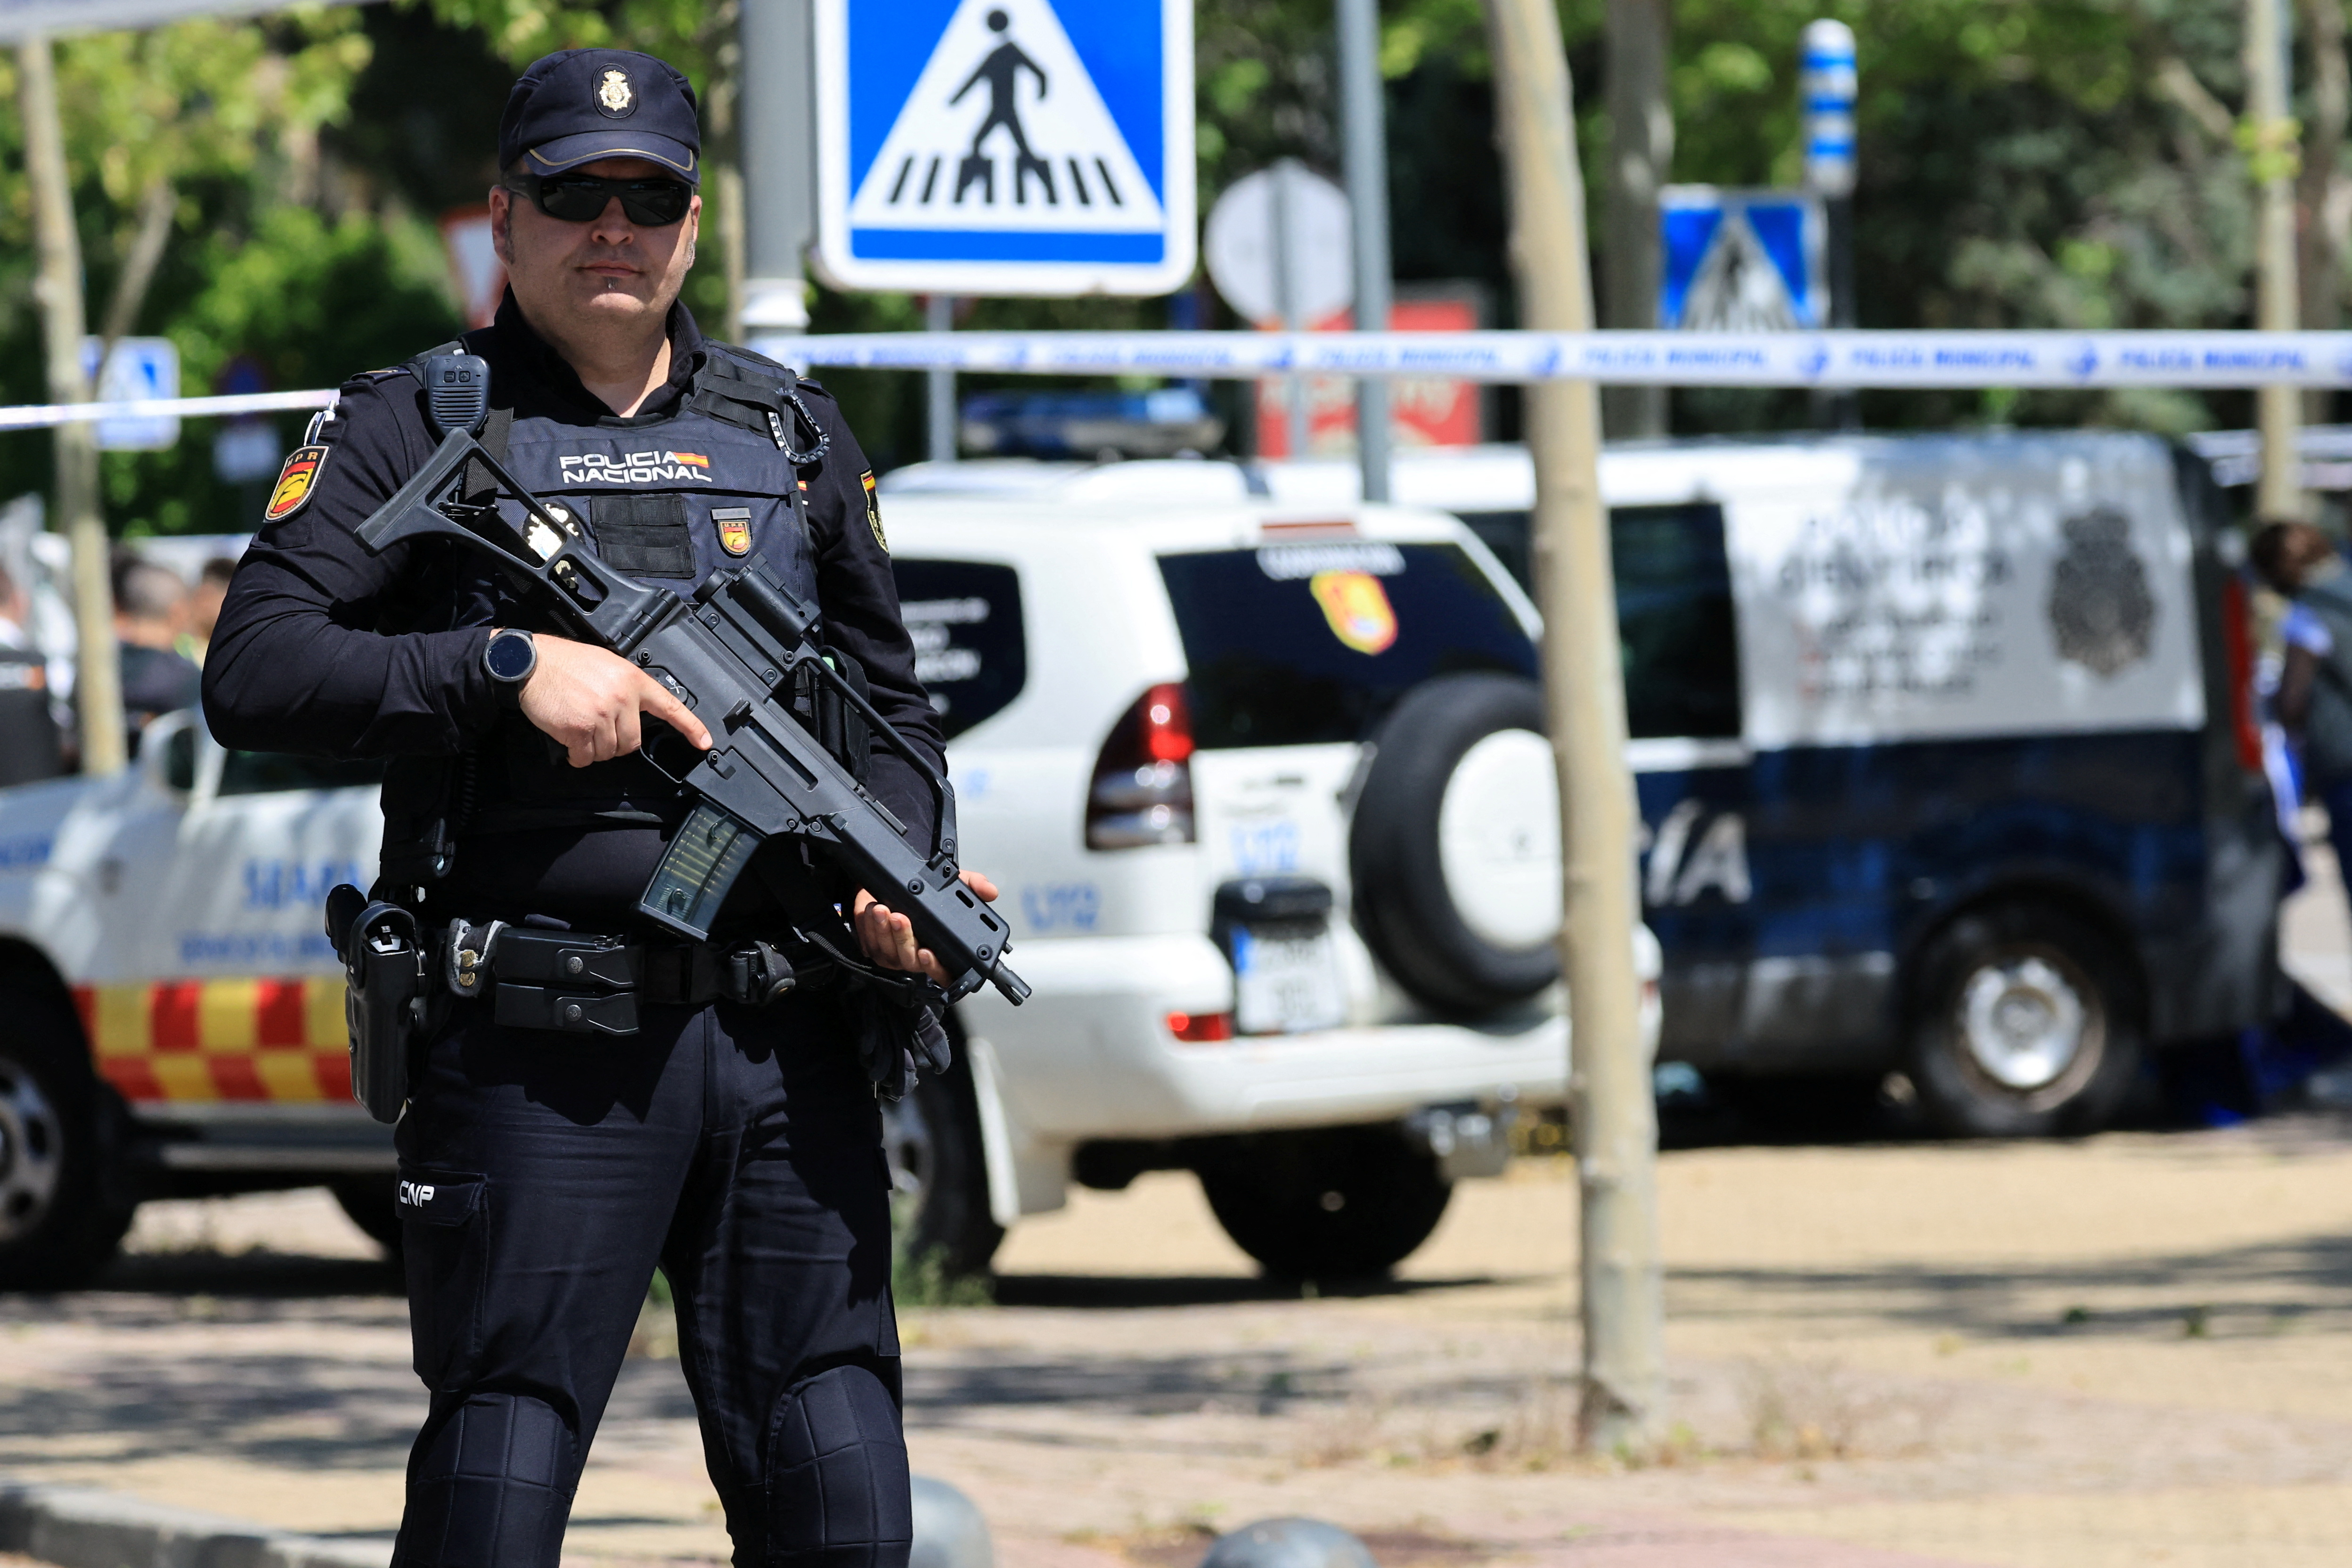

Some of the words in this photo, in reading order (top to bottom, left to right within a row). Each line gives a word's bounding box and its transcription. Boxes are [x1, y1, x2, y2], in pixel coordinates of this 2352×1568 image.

[559, 451, 681, 469] POLICIA
[563, 466, 712, 483] NACIONAL
[400, 1180, 434, 1207] CNP
